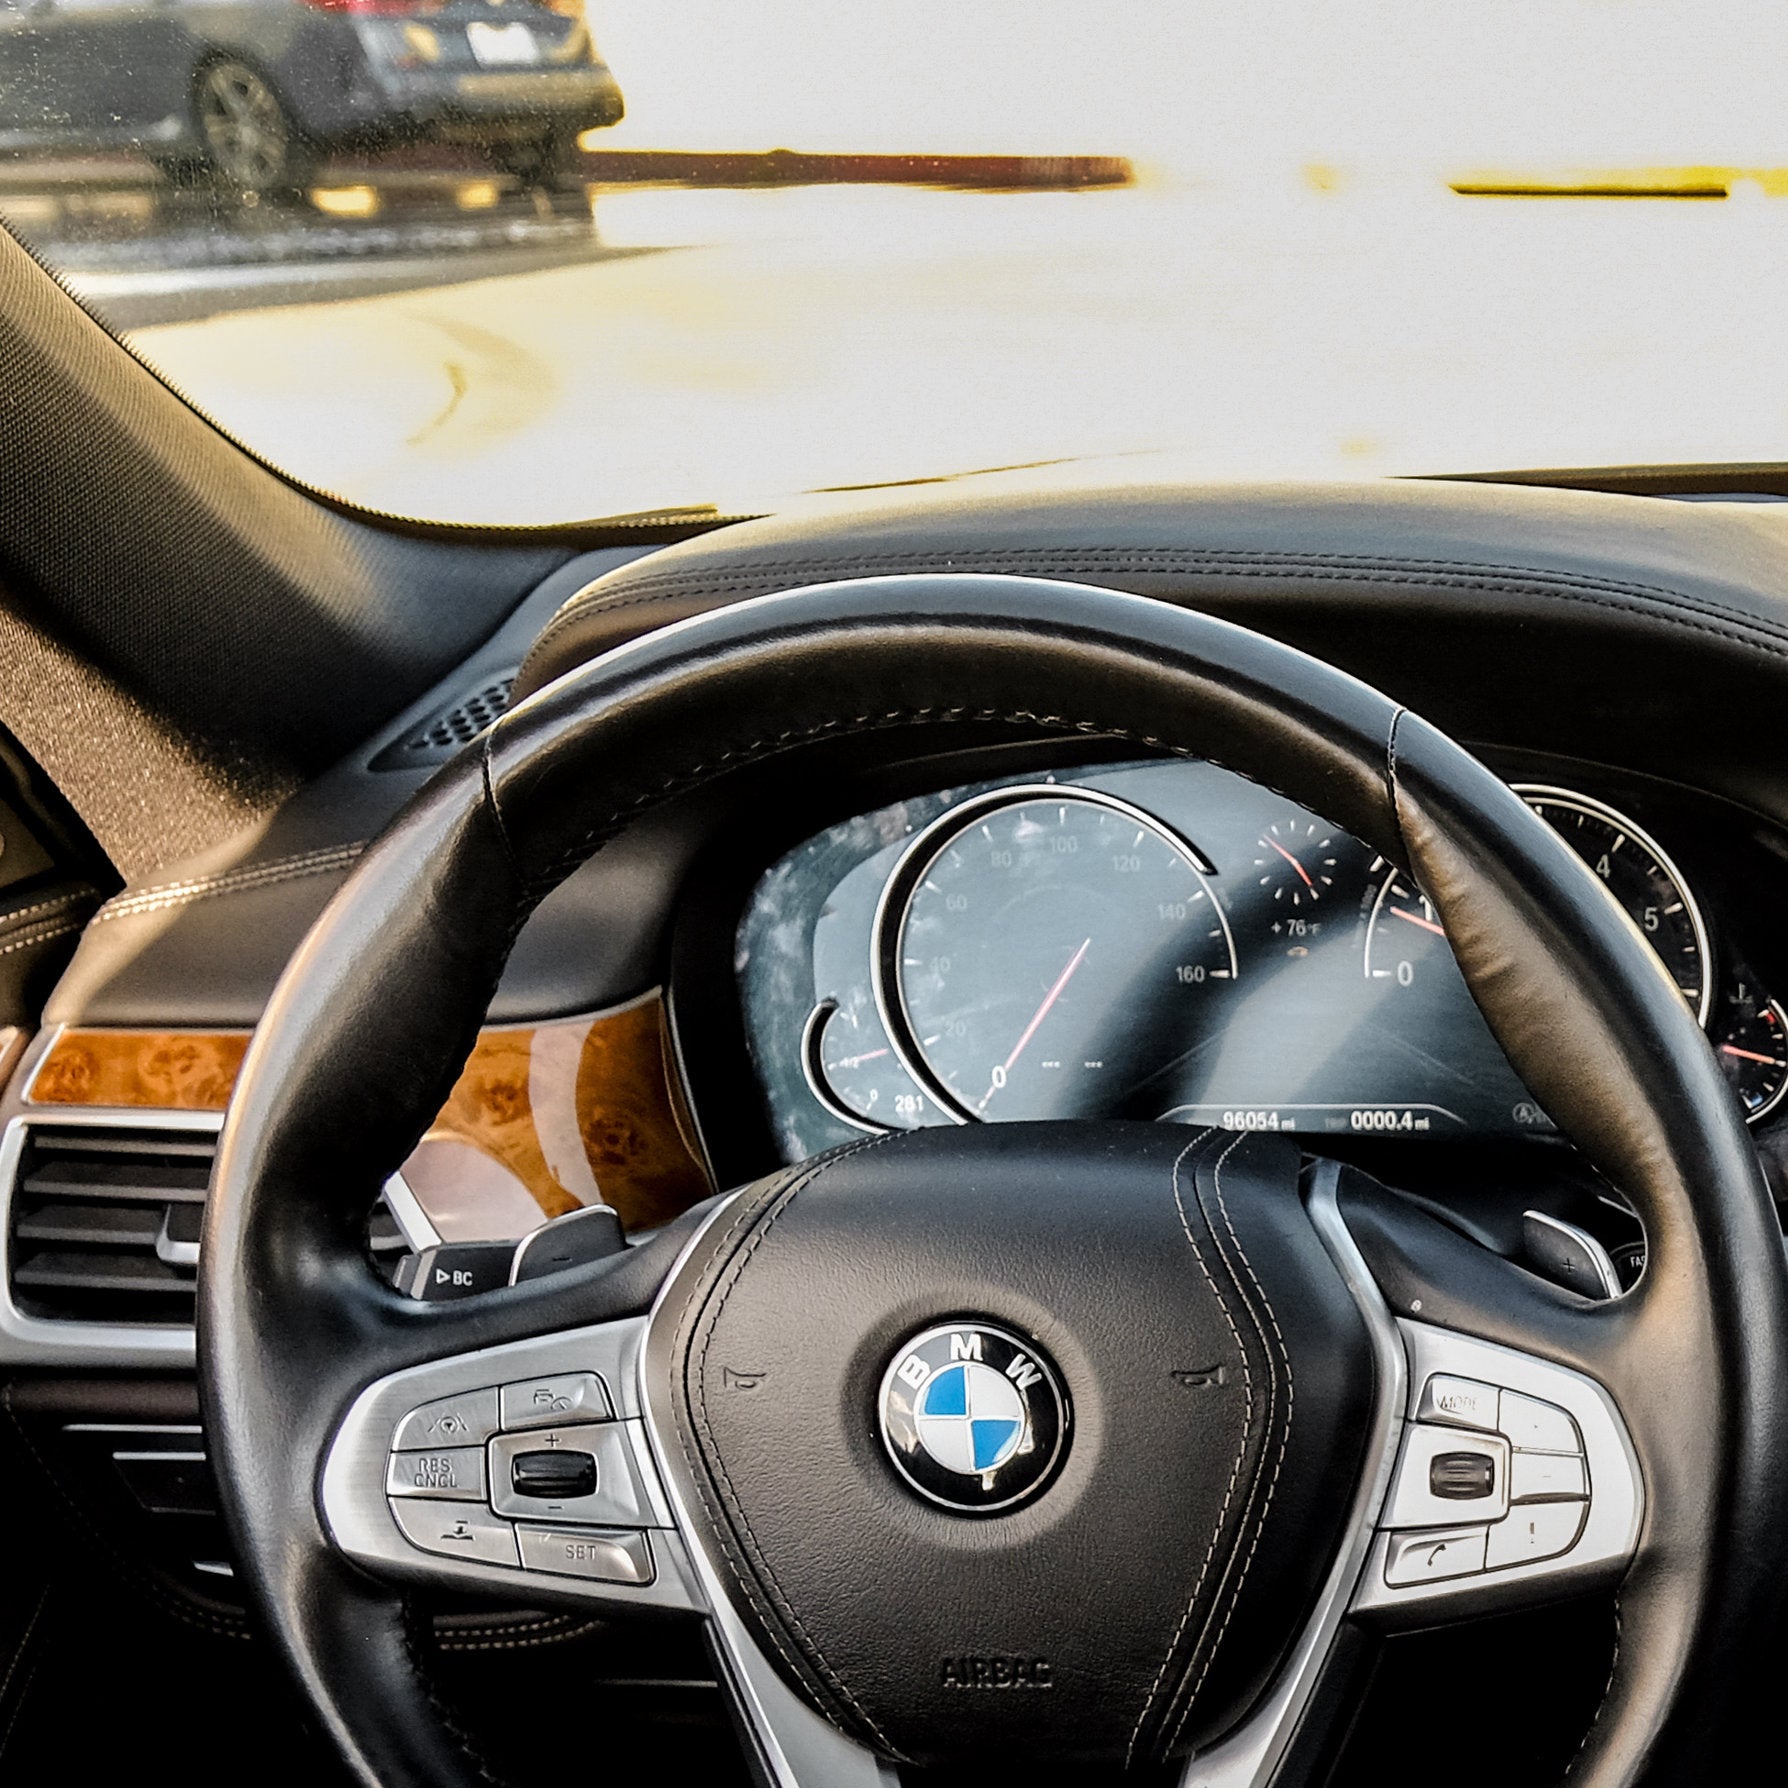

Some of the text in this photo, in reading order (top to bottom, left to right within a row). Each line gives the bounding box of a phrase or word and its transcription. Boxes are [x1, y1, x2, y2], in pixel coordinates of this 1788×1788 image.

[1049, 836, 1079, 853] 100
[991, 852, 1012, 868] 80
[1112, 854, 1141, 872] 120
[1596, 854, 1611, 878] 4
[946, 894, 968, 911] 60
[1158, 903, 1187, 921] 140
[1643, 906, 1659, 932] 5
[1175, 965, 1206, 983] 160
[1398, 960, 1413, 987] 0
[991, 1065, 1008, 1088] 0
[1222, 1110, 1279, 1131] 96054
[1350, 1110, 1413, 1131] 0000.4
[452, 1269, 473, 1287] BC
[897, 1332, 1043, 1390] BMW
[418, 1457, 451, 1474] RES
[413, 1473, 458, 1490] CNCL
[565, 1544, 597, 1561] SET
[942, 1656, 1053, 1689] AIRBAG
